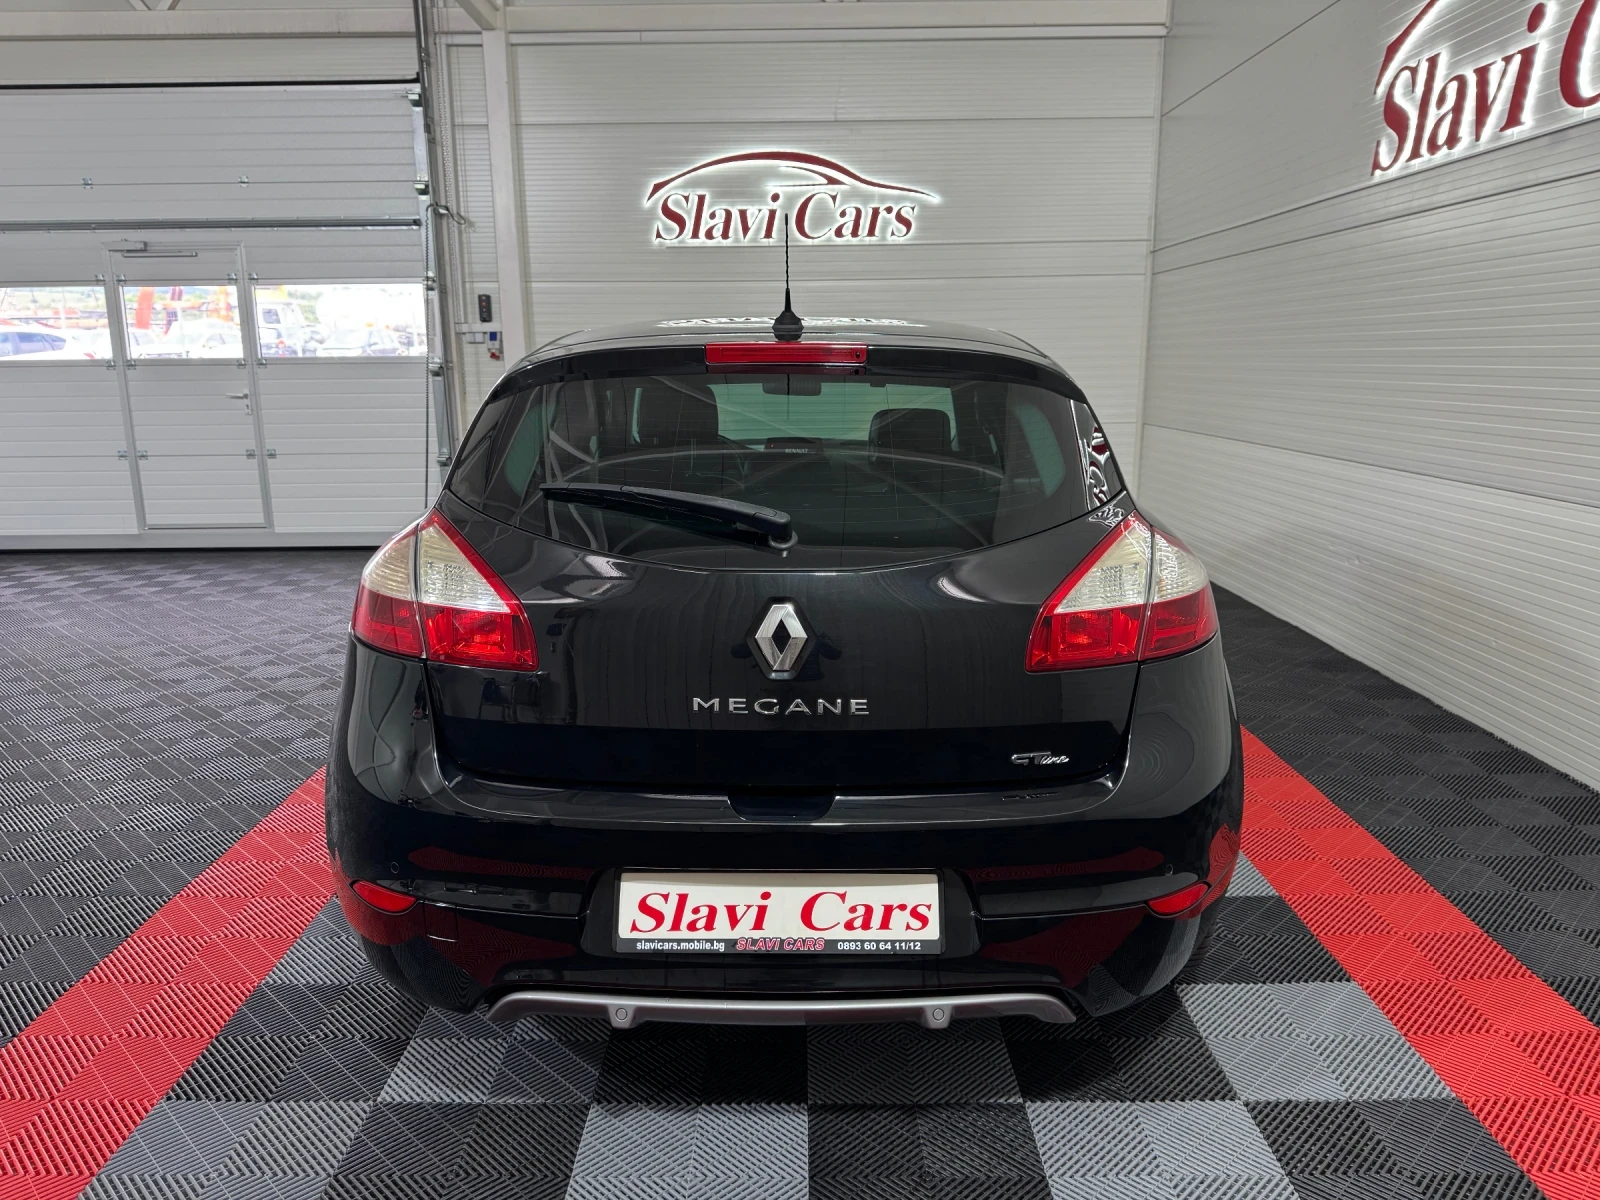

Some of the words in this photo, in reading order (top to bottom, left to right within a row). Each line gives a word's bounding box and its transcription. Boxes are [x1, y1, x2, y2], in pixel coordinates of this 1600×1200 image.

[1370, 2, 1546, 177] Slavi
[655, 192, 781, 241] Slavi
[794, 191, 917, 240] Cars
[692, 697, 870, 716] MEGANE
[630, 891, 772, 933] Slavi
[800, 890, 932, 932] Cars
[636, 940, 725, 952] slavicars.mobile.bg
[736, 937, 780, 950] SLAVI
[783, 937, 825, 950] CARS
[837, 941, 862, 951] 0893
[864, 941, 877, 951] 60
[879, 941, 892, 951] 64
[894, 941, 921, 951] 11/12
